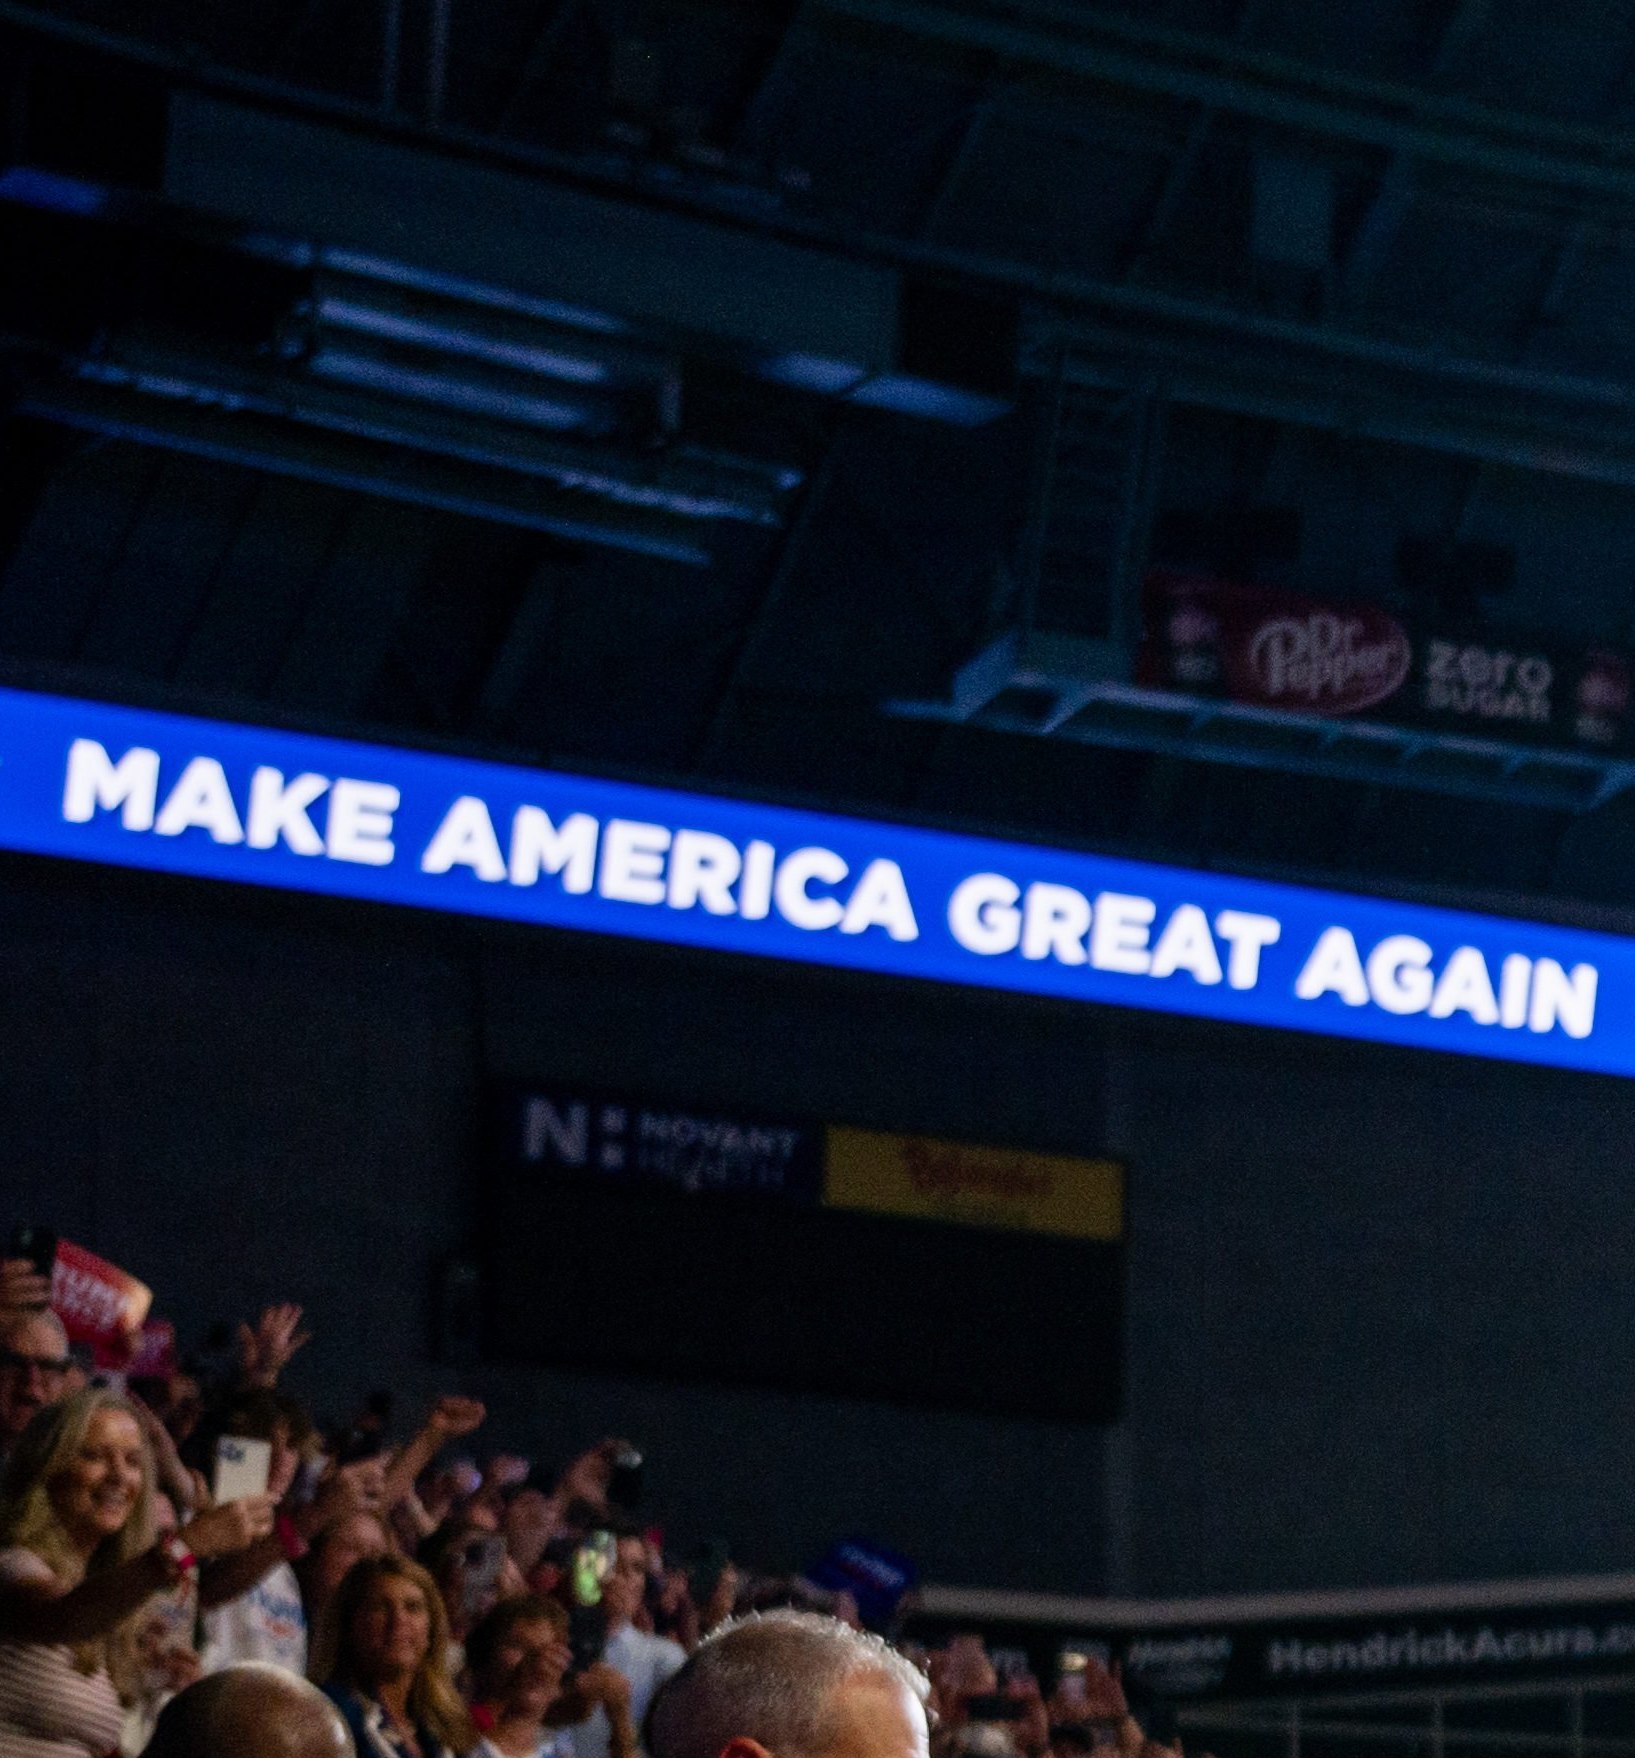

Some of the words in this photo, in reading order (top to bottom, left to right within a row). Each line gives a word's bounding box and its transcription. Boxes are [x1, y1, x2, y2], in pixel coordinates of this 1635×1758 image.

[1252, 617, 1400, 699] Pepper
[1312, 612, 1363, 652] Dr
[1427, 638, 1554, 695] zero
[1425, 683, 1551, 723] SUGAR
[60, 736, 401, 867] MAKE
[421, 796, 919, 944] AMERICA
[946, 872, 1279, 990] GREAT
[1294, 923, 1599, 1040] AGAIN
